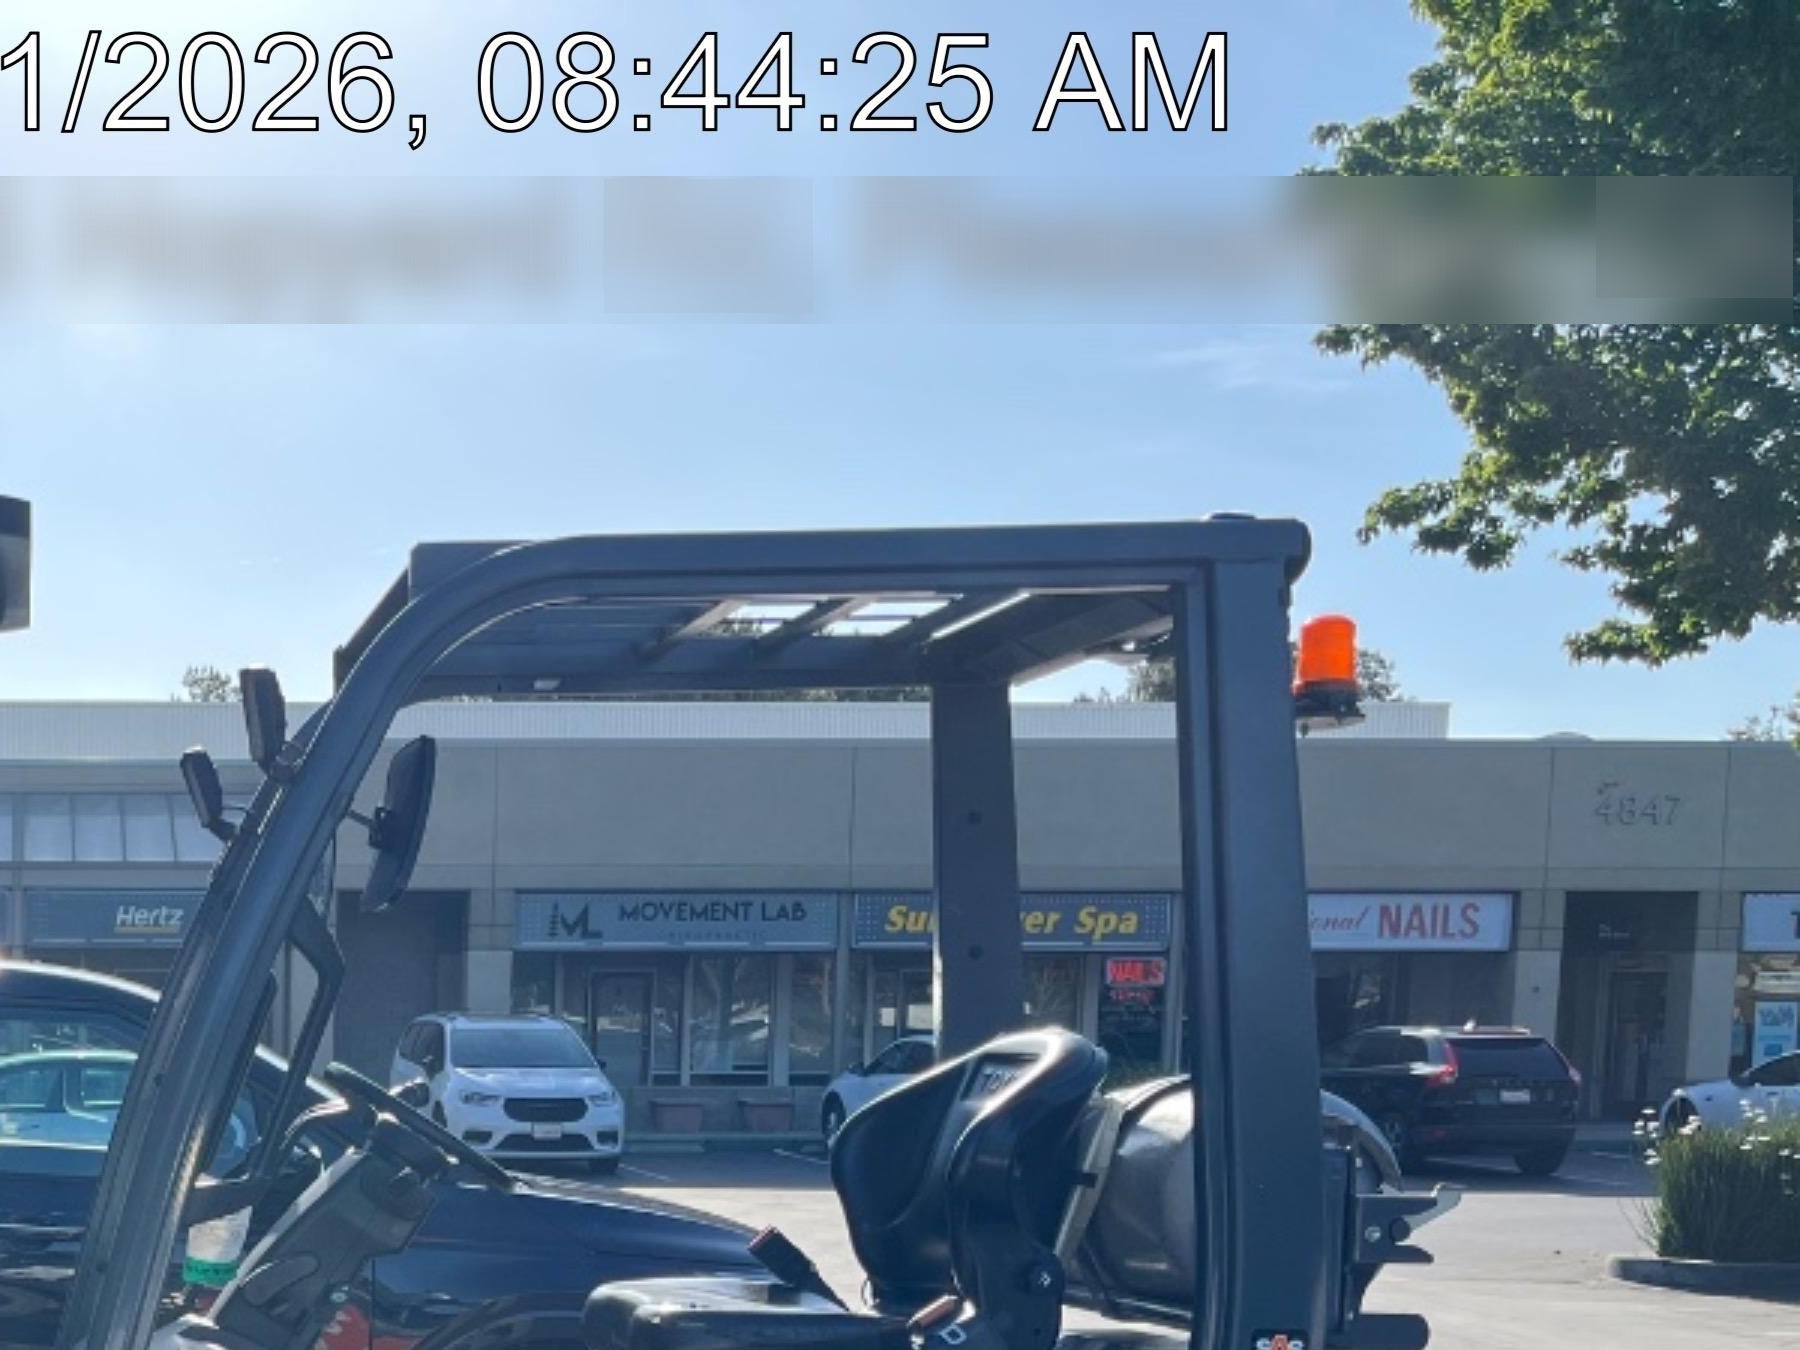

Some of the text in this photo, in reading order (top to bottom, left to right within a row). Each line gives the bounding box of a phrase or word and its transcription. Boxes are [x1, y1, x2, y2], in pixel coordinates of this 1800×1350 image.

[115, 905, 185, 926] Hertz
[617, 902, 808, 922] MOVEMENT LAB
[1074, 904, 1139, 940] Spa
[1378, 902, 1481, 939] NAILS
